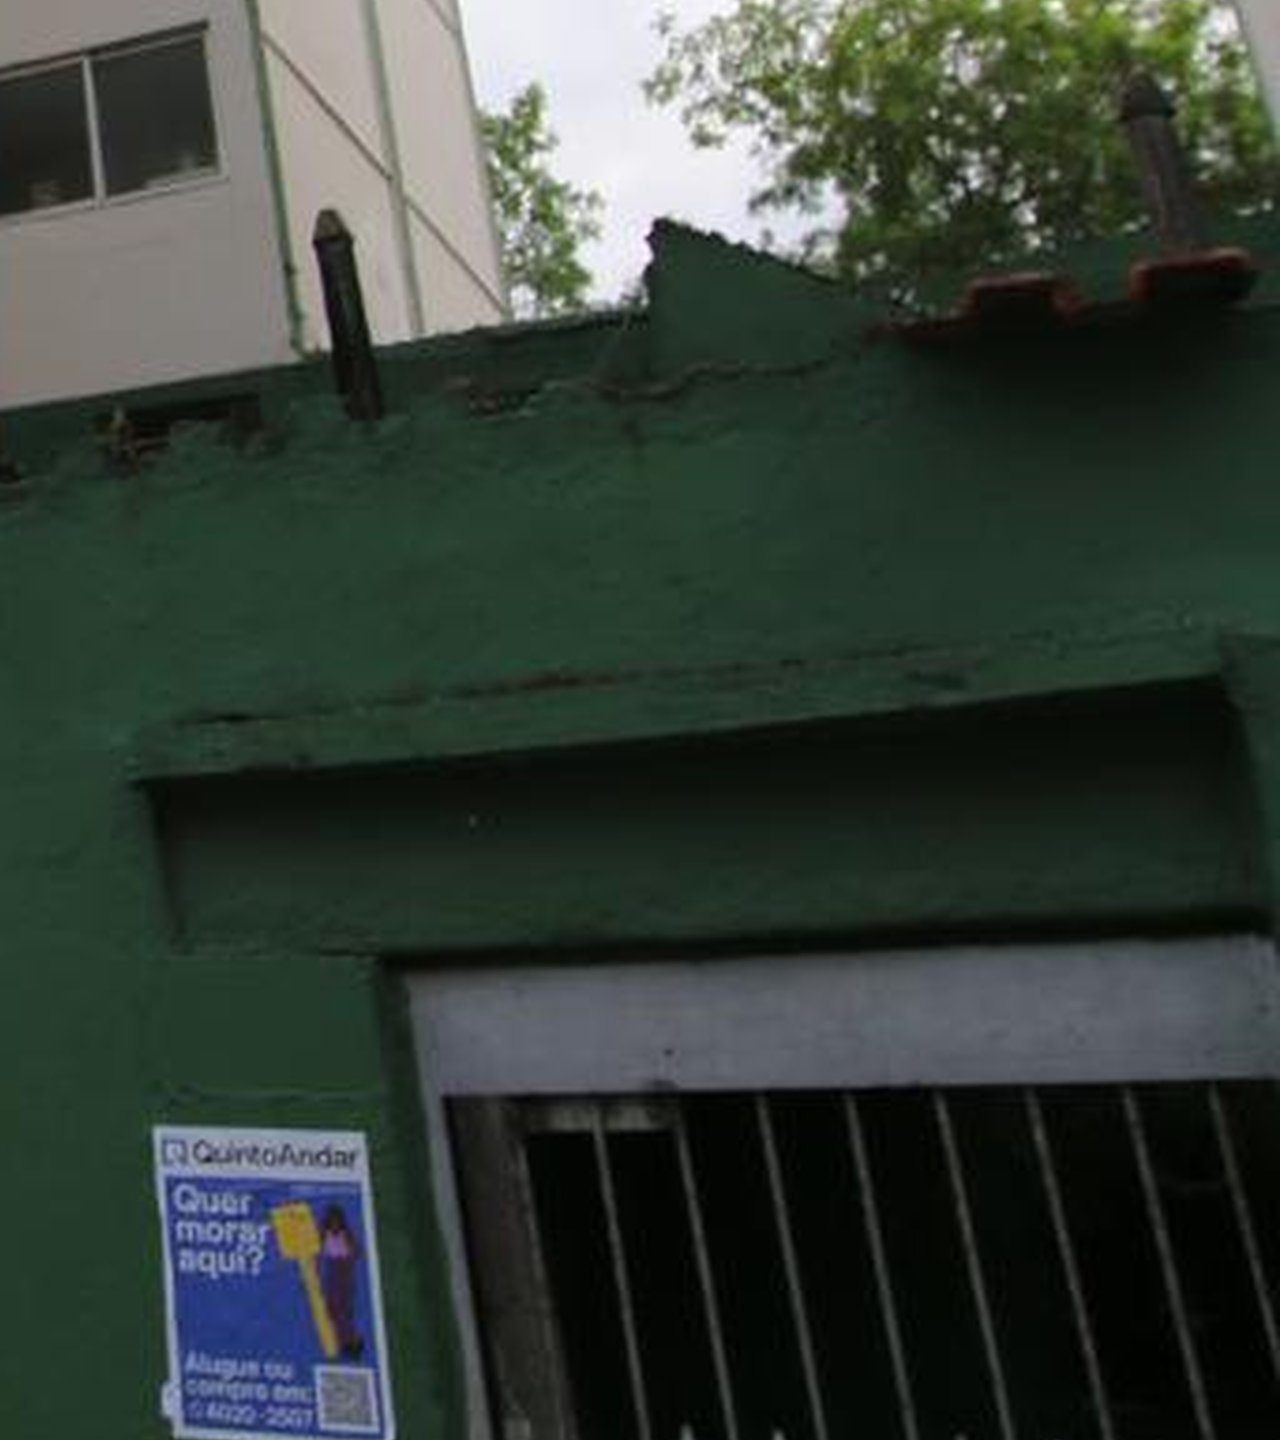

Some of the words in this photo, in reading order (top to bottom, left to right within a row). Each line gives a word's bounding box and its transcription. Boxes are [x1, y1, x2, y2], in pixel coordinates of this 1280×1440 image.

[193, 1139, 357, 1169] QuintoAndar
[173, 1183, 254, 1215] Quer
[176, 1221, 269, 1245] morar
[178, 1245, 264, 1279] aqui?
